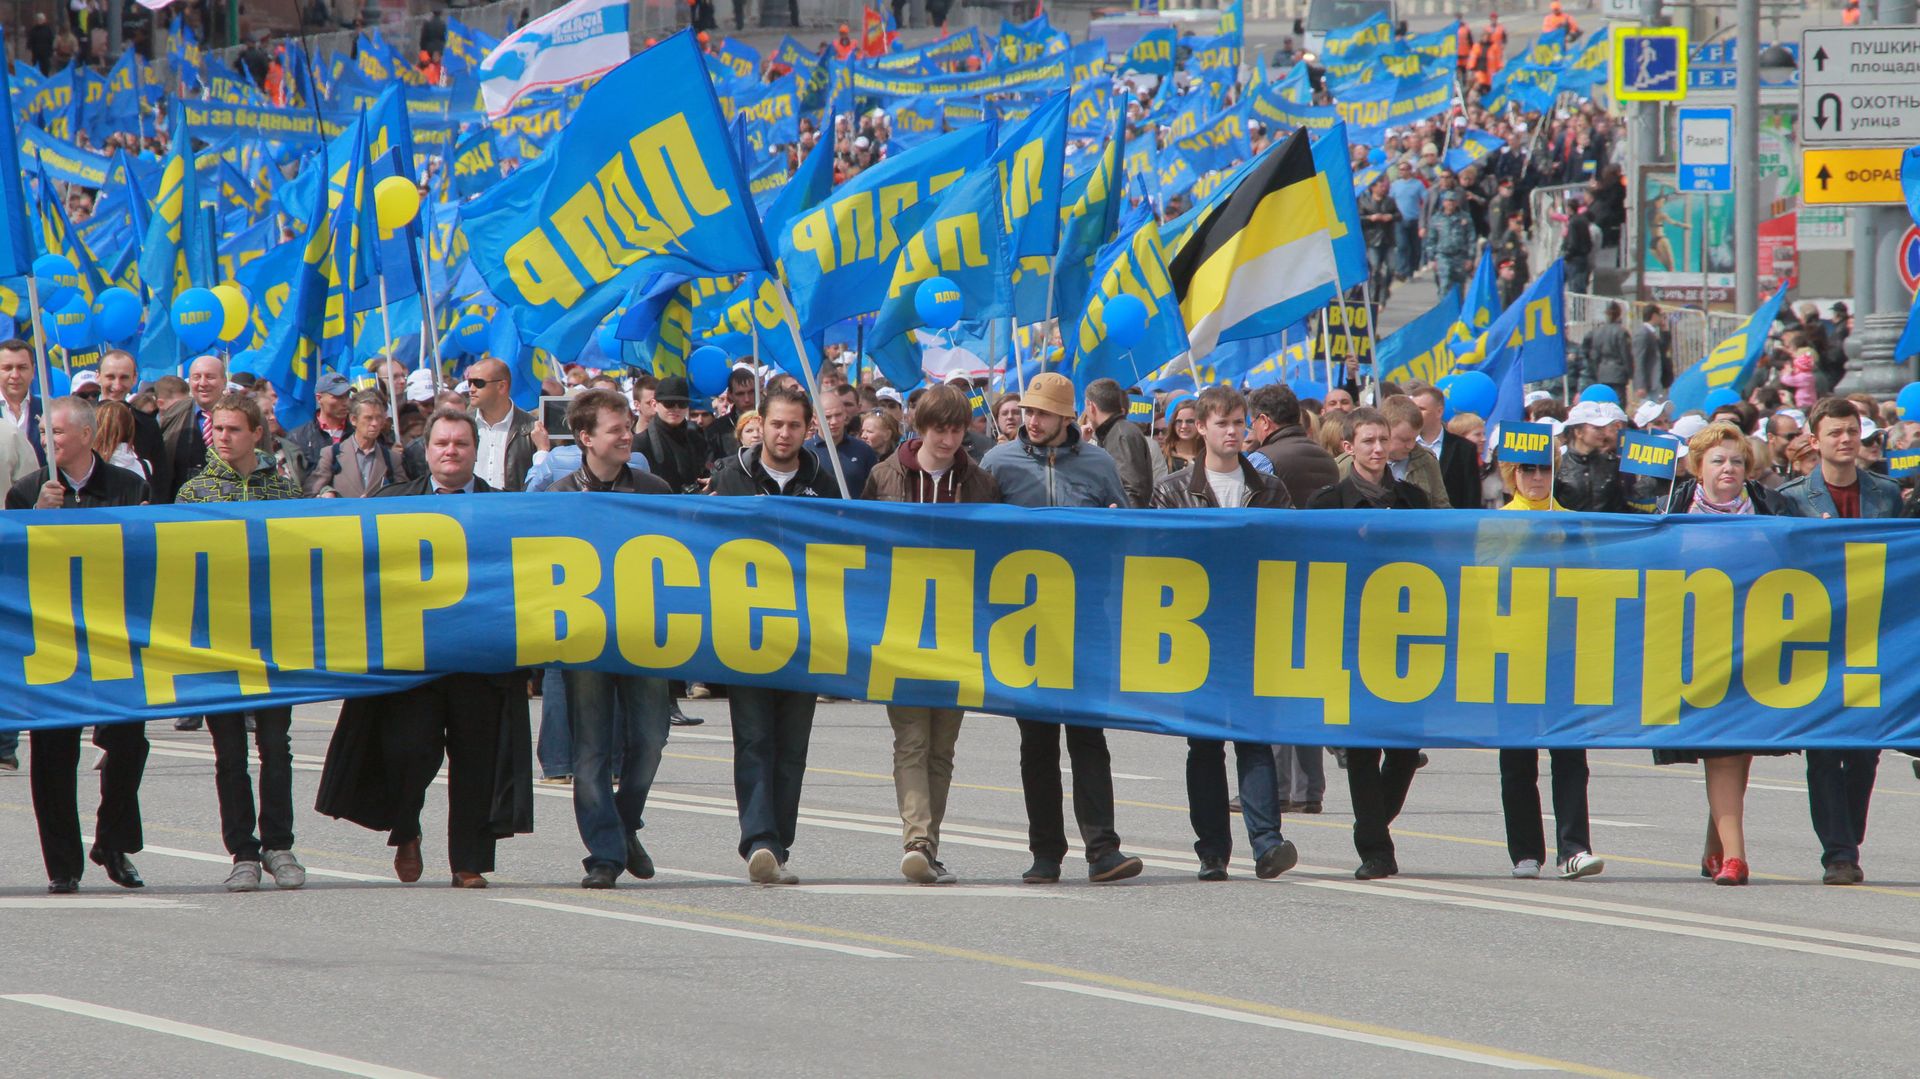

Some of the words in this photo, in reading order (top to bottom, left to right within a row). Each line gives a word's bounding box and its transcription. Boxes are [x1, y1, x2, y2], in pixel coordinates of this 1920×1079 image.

[211, 109, 233, 125] за
[1851, 117, 1900, 130] улица
[1686, 135, 1724, 148] Радио
[180, 310, 212, 326] ЛДПР
[71, 352, 100, 368] ЛДПР
[1504, 432, 1550, 452] ЛДПР
[1627, 443, 1675, 466] ЛДПР
[24, 512, 469, 705] ЛДПР
[511, 534, 1076, 708] всегда
[1120, 555, 1211, 694] в
[1253, 542, 1888, 726] центре!
